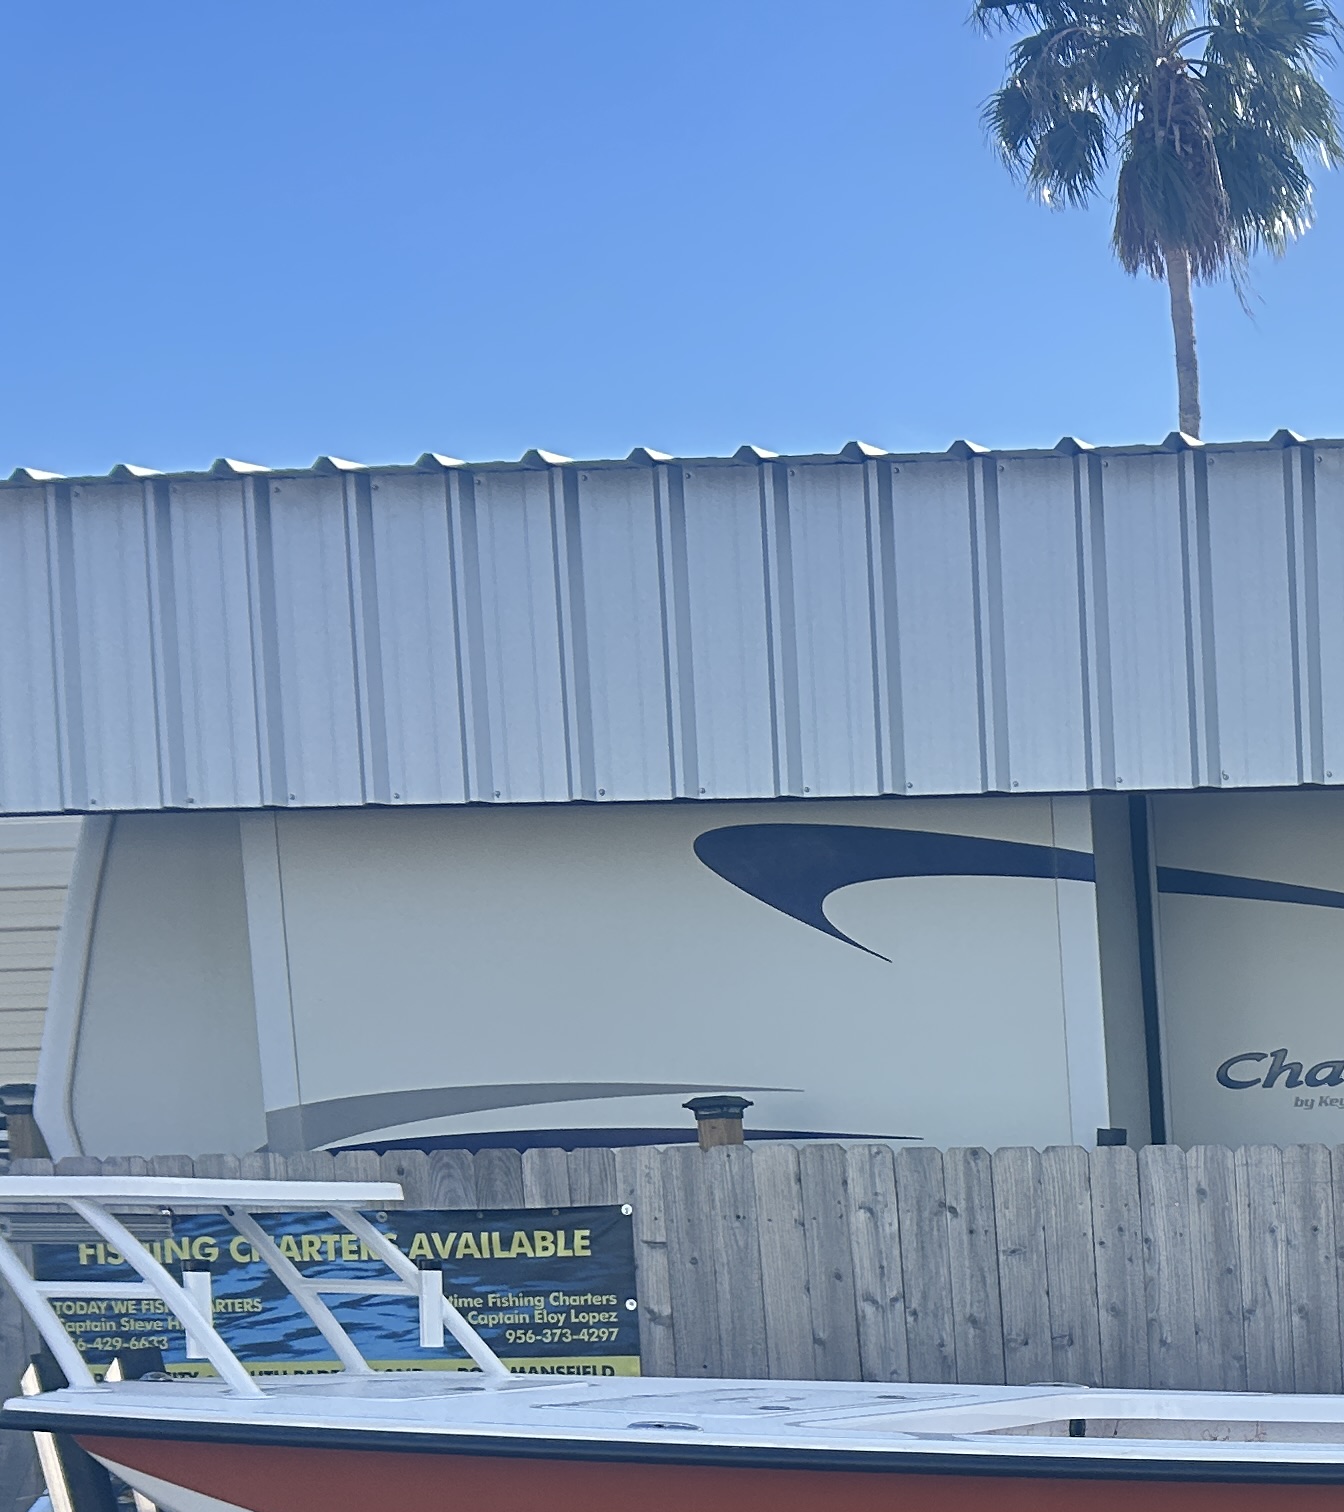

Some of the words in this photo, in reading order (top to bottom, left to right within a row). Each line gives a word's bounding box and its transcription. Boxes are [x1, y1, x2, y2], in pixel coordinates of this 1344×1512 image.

[1293, 1096, 1315, 1110] by
[408, 1229, 592, 1260] AVAILABLE
[53, 1300, 108, 1315] TODAY
[111, 1300, 137, 1314] WE
[487, 1292, 545, 1310] Fishing
[549, 1291, 618, 1307] Charters
[60, 1317, 116, 1335] aptain
[121, 1317, 163, 1331] Steve
[467, 1309, 530, 1328] Captain
[534, 1309, 566, 1326] Eloy
[570, 1310, 618, 1326] Lopez
[72, 1335, 169, 1351] 6-429-6633
[505, 1327, 619, 1344] 956-373-4297
